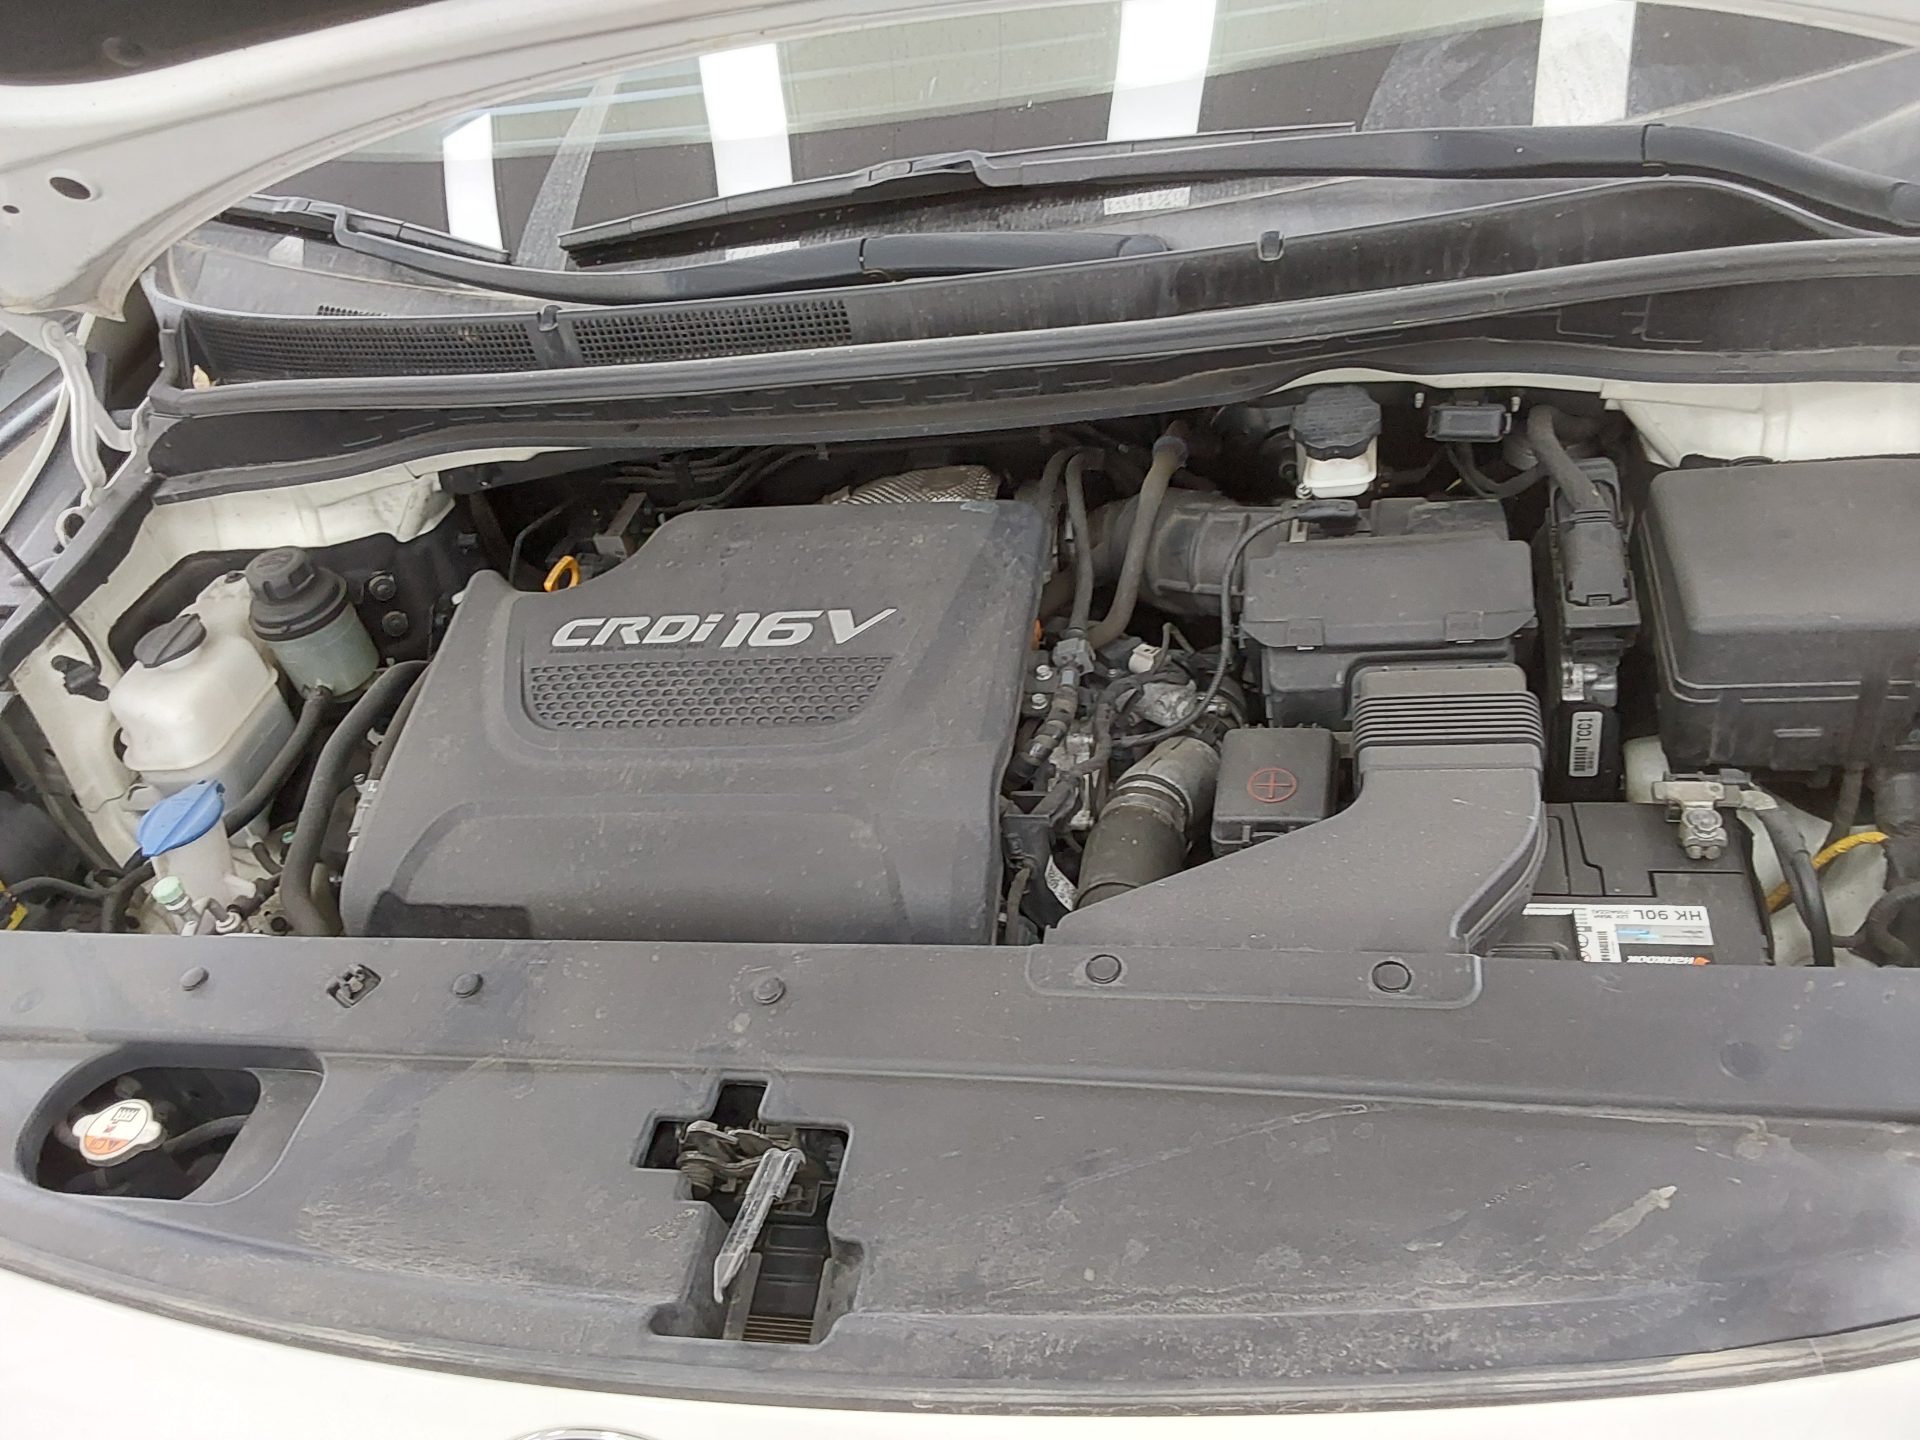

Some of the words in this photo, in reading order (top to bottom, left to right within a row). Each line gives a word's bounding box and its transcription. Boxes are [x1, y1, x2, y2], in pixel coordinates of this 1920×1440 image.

[551, 613, 725, 647] CRDi
[719, 608, 899, 648] 16V
[1633, 909, 1669, 920] 90L
[1674, 910, 1703, 921] HK
